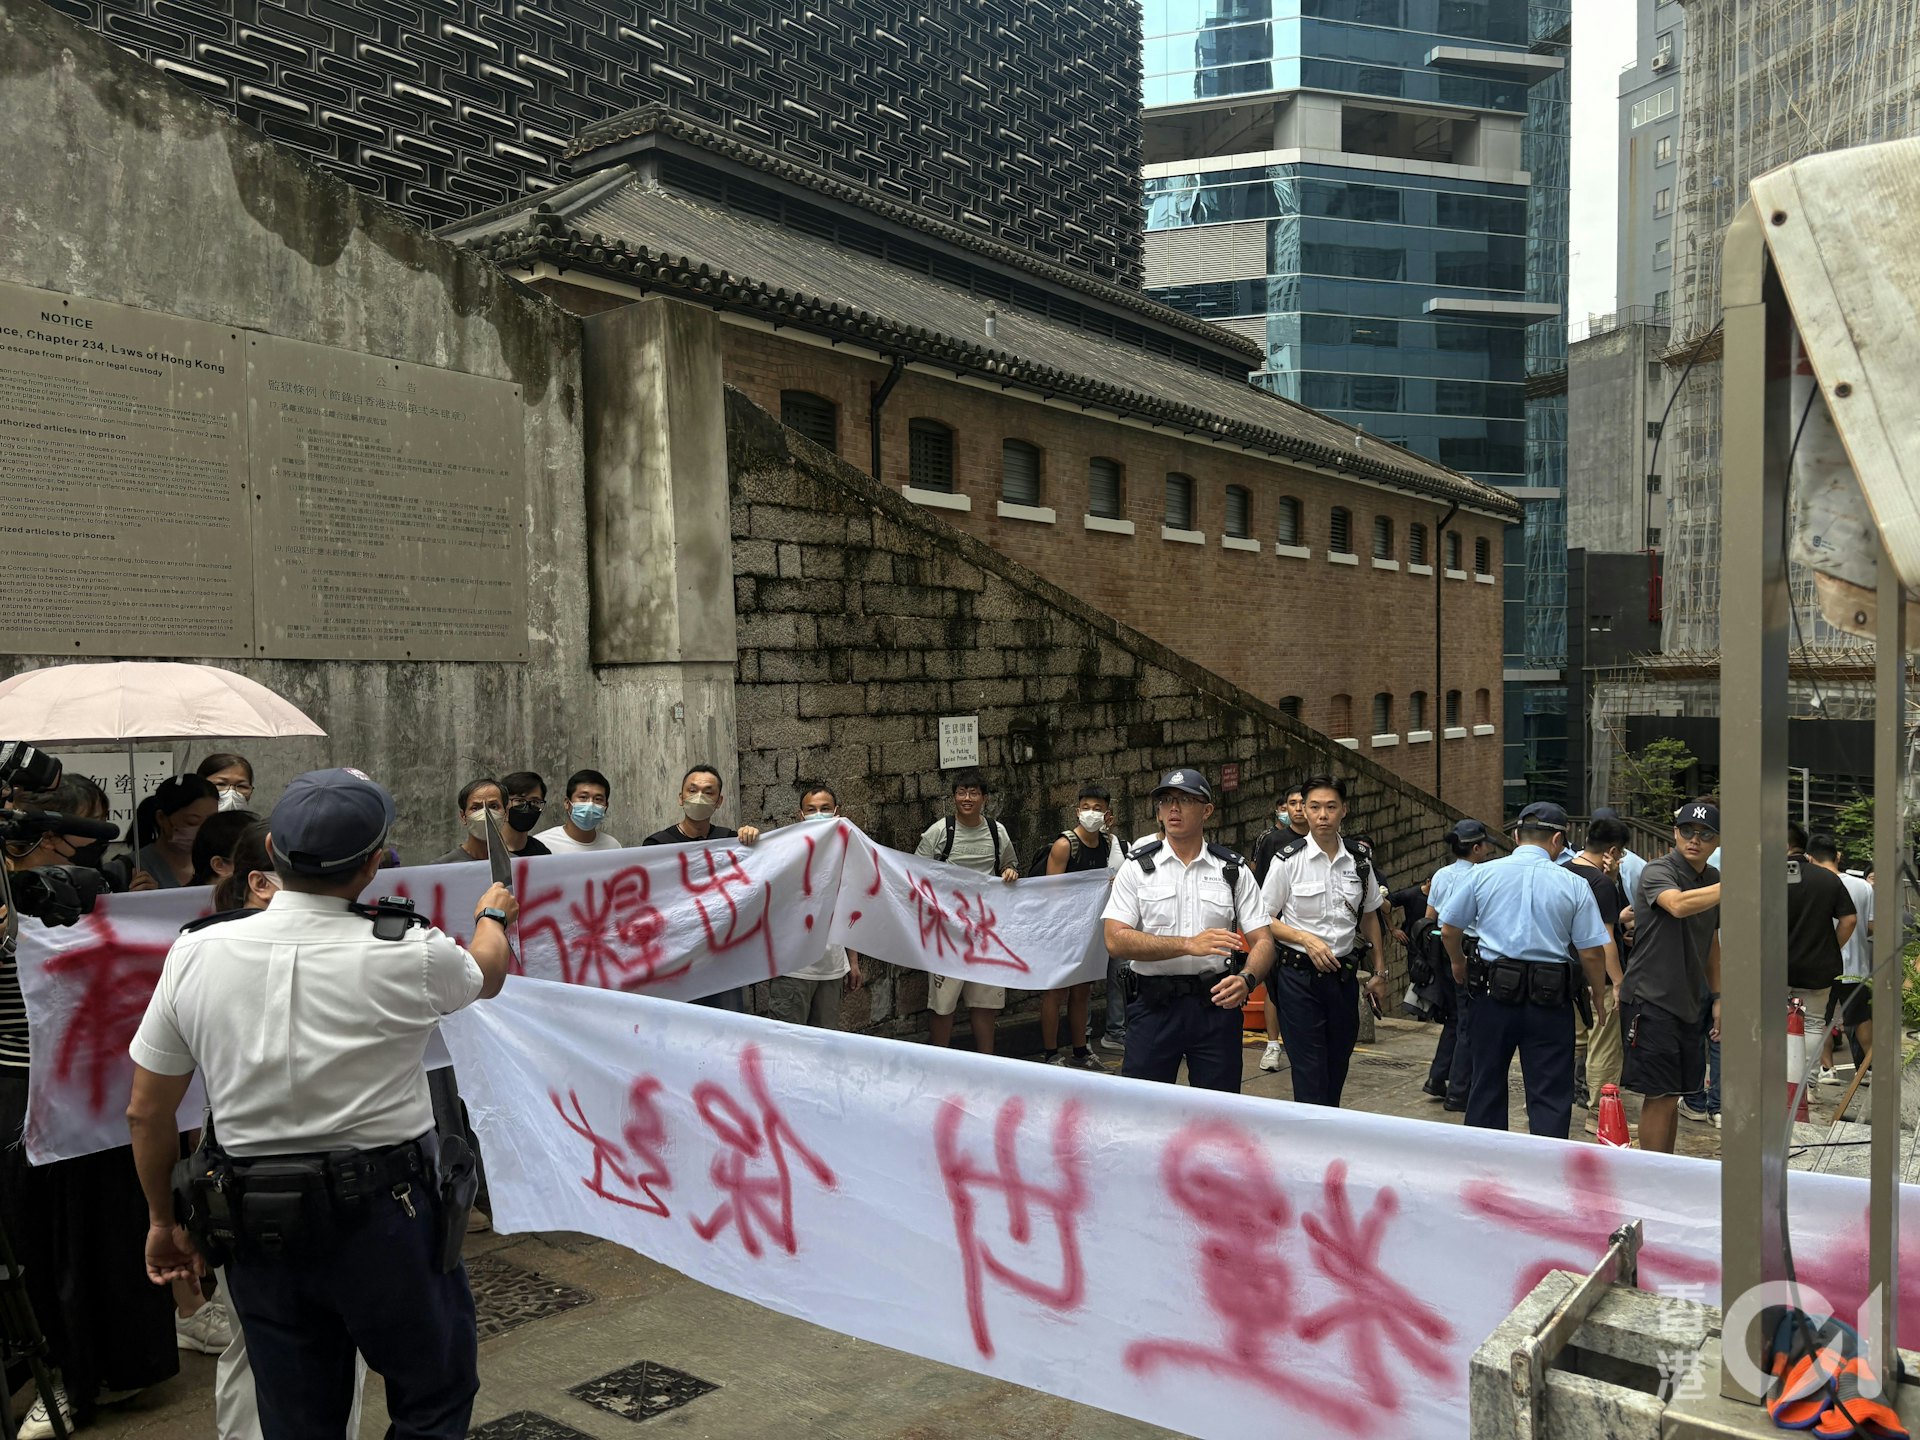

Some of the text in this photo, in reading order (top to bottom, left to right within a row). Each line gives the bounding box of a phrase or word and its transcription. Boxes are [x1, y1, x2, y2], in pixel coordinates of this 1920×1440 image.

[41, 311, 93, 329] NOTICE
[26, 329, 78, 348] Chapter
[82, 338, 107, 353] 234,
[111, 344, 142, 357] Laws
[146, 350, 158, 360] of
[161, 353, 191, 368] Hong
[195, 359, 224, 374] Kong
[7, 345, 39, 357] escape
[42, 350, 62, 359] from
[65, 354, 93, 365] prison
[106, 361, 127, 371] legal
[129, 365, 162, 377] custody
[43, 423, 77, 433] articles
[98, 431, 126, 441] prison
[25, 527, 59, 535] articles
[73, 531, 115, 540] prisoners
